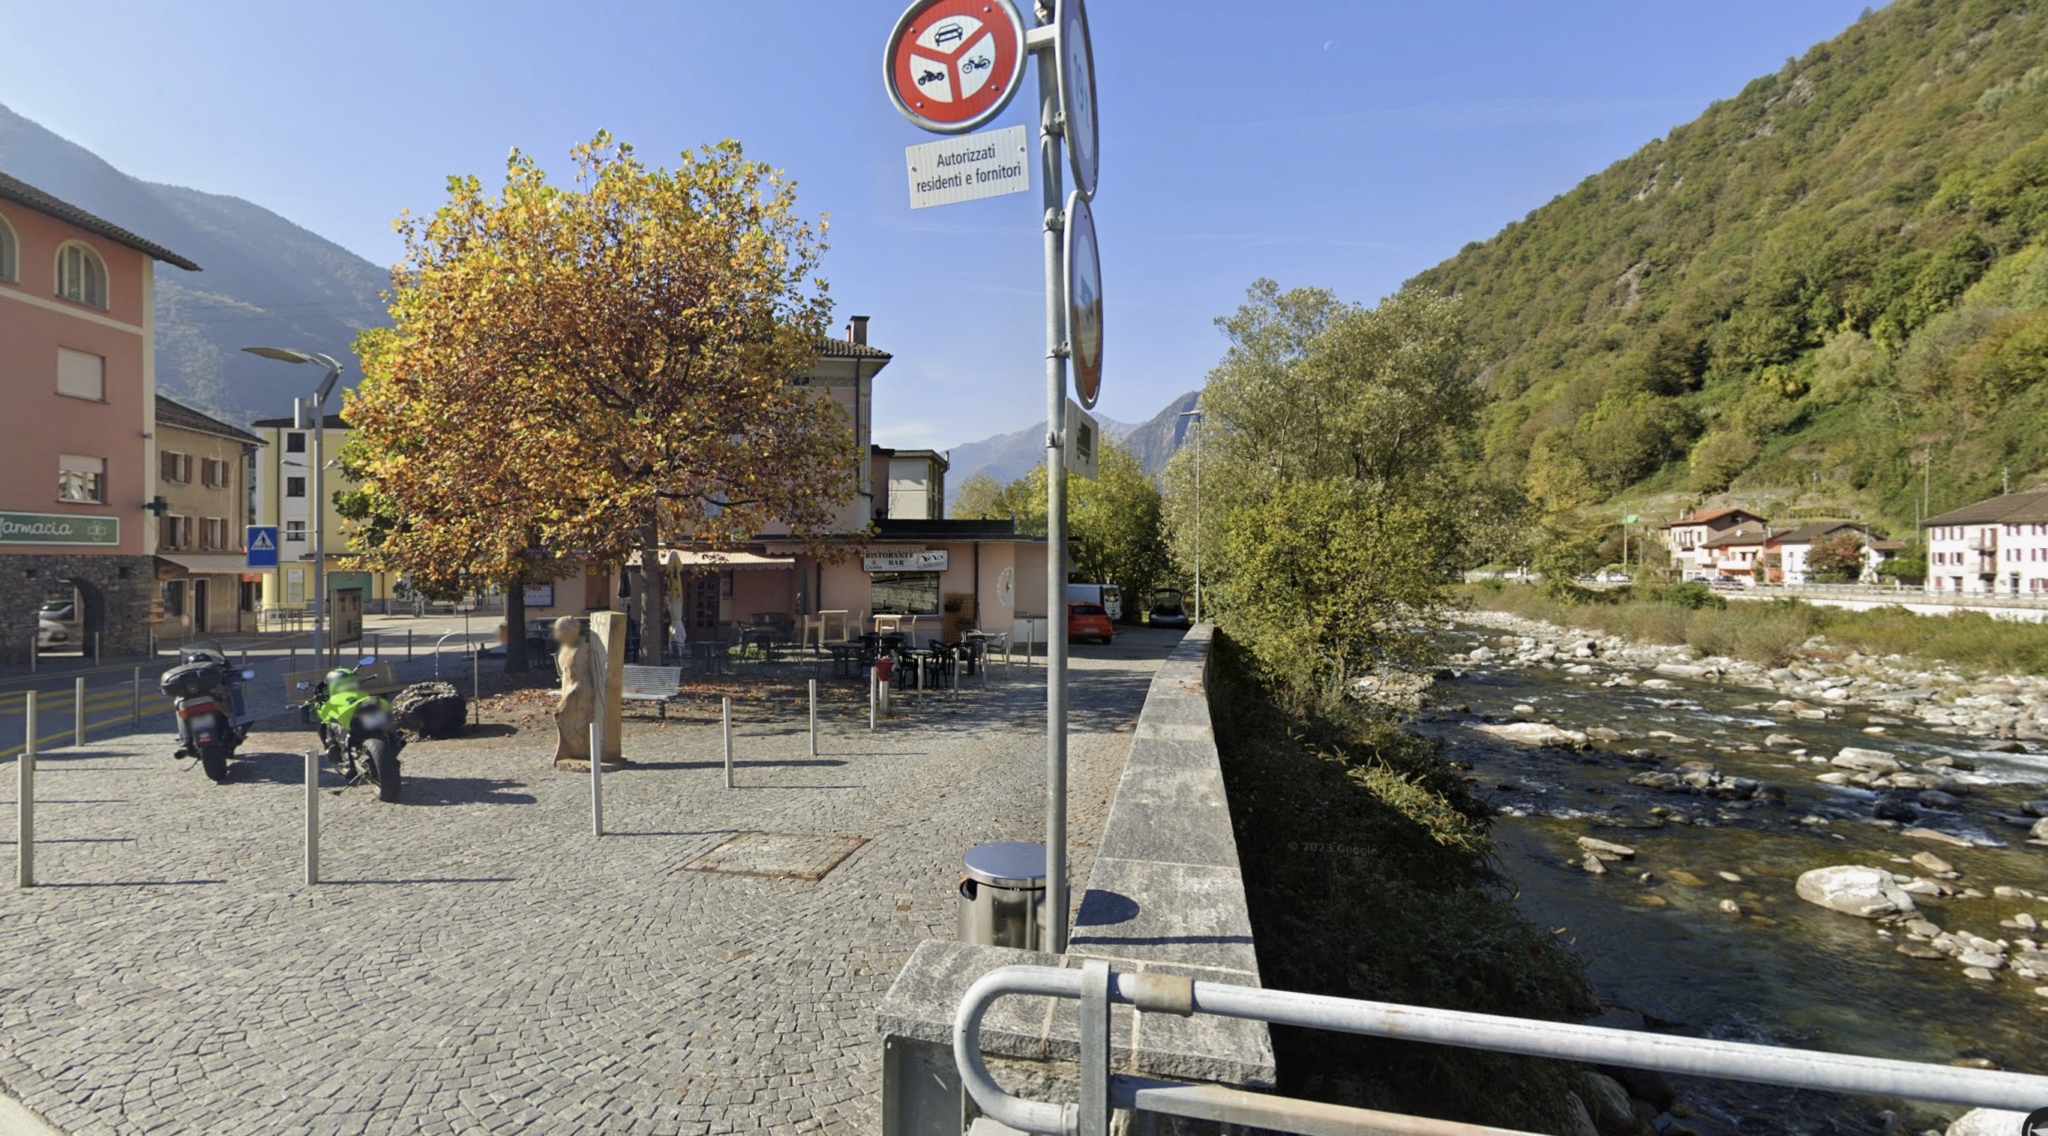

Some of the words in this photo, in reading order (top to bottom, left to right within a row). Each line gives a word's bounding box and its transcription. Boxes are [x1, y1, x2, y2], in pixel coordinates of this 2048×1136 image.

[937, 144, 996, 168] Autorizzati
[916, 172, 962, 194] residenti
[966, 173, 972, 185] e
[975, 161, 1022, 184] fornitori
